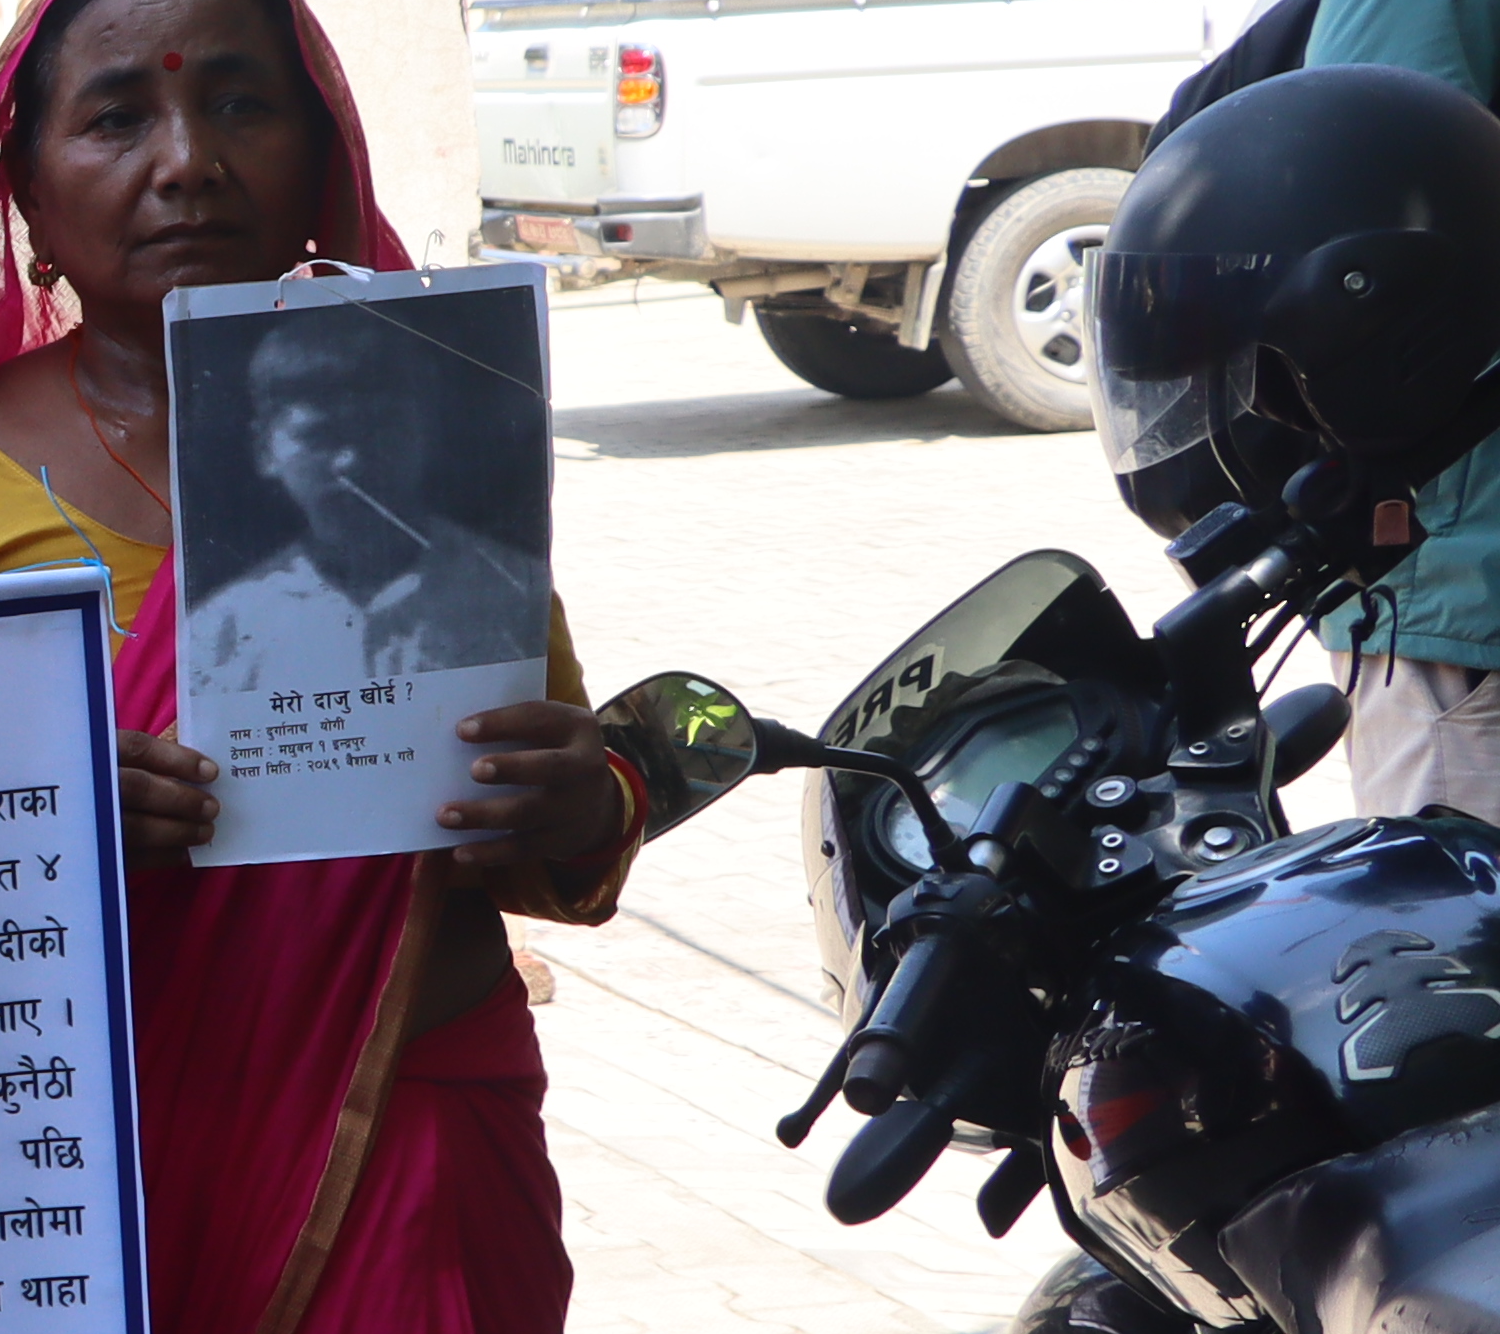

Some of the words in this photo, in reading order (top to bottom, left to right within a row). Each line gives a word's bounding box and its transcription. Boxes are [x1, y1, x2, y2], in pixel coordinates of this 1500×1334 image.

[503, 138, 576, 167] Mahindra
[268, 689, 304, 715] मेरो
[312, 689, 352, 714] दाजु
[359, 679, 396, 706] खोई
[230, 728, 251, 741] नाम
[320, 717, 345, 732] योगी
[230, 746, 263, 761] ठेगाना
[266, 760, 292, 776] मिति
[397, 747, 415, 762] गते
[37, 855, 60, 880] ४
[22, 1276, 88, 1306] थाहा
